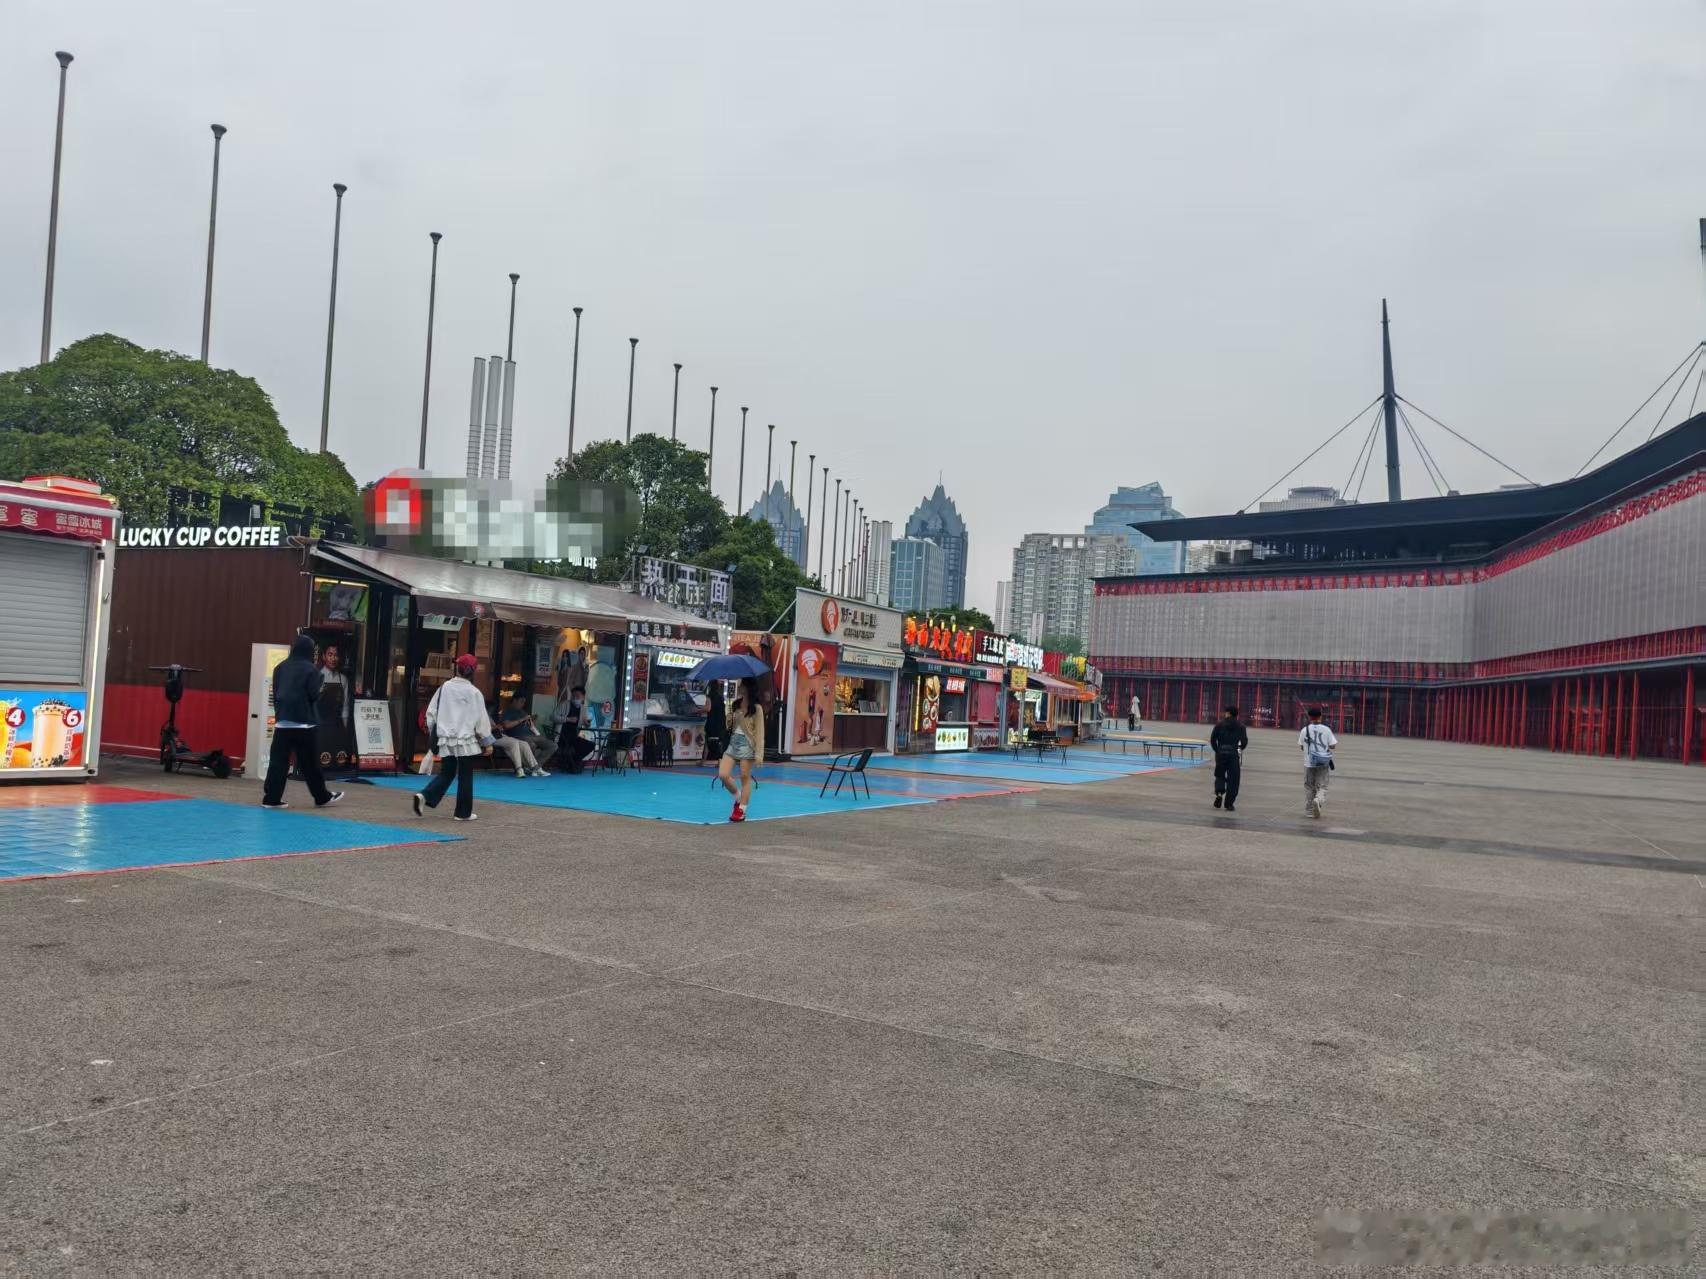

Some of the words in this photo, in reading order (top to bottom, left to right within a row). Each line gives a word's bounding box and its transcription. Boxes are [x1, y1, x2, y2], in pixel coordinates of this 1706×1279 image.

[119, 527, 175, 547] LUCKY
[176, 526, 211, 547] CUP
[214, 525, 281, 546] COFFEE
[8, 708, 22, 726] 4
[66, 709, 79, 726] 6
